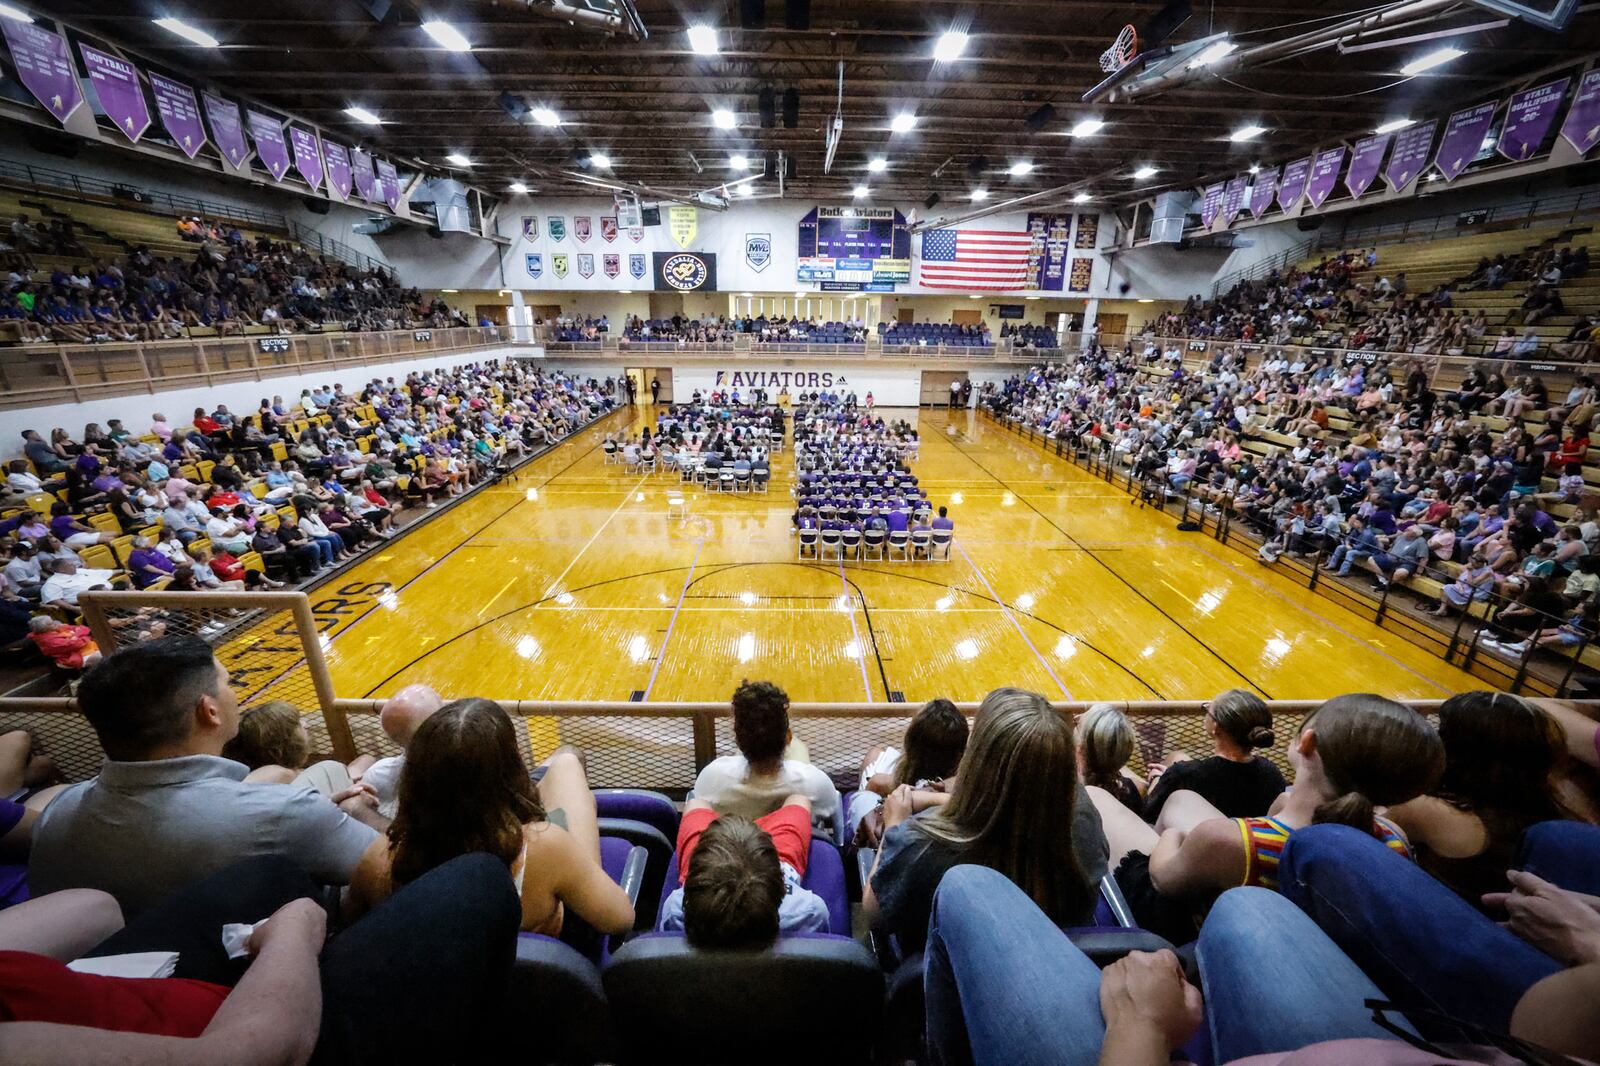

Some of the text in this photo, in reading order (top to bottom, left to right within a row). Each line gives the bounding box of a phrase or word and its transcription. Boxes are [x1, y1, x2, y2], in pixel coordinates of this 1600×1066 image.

[86, 51, 132, 75] SOFTBALL
[151, 77, 193, 99] VOLLEYBALL
[1524, 86, 1553, 101] STATE
[1511, 91, 1562, 112] QUALIFIERS
[1452, 112, 1472, 122] FINAL
[1455, 116, 1483, 128] FOOTBALL
[853, 208, 893, 218] Aviators
[261, 338, 288, 346] SECTION
[731, 371, 833, 388] AVIATORS
